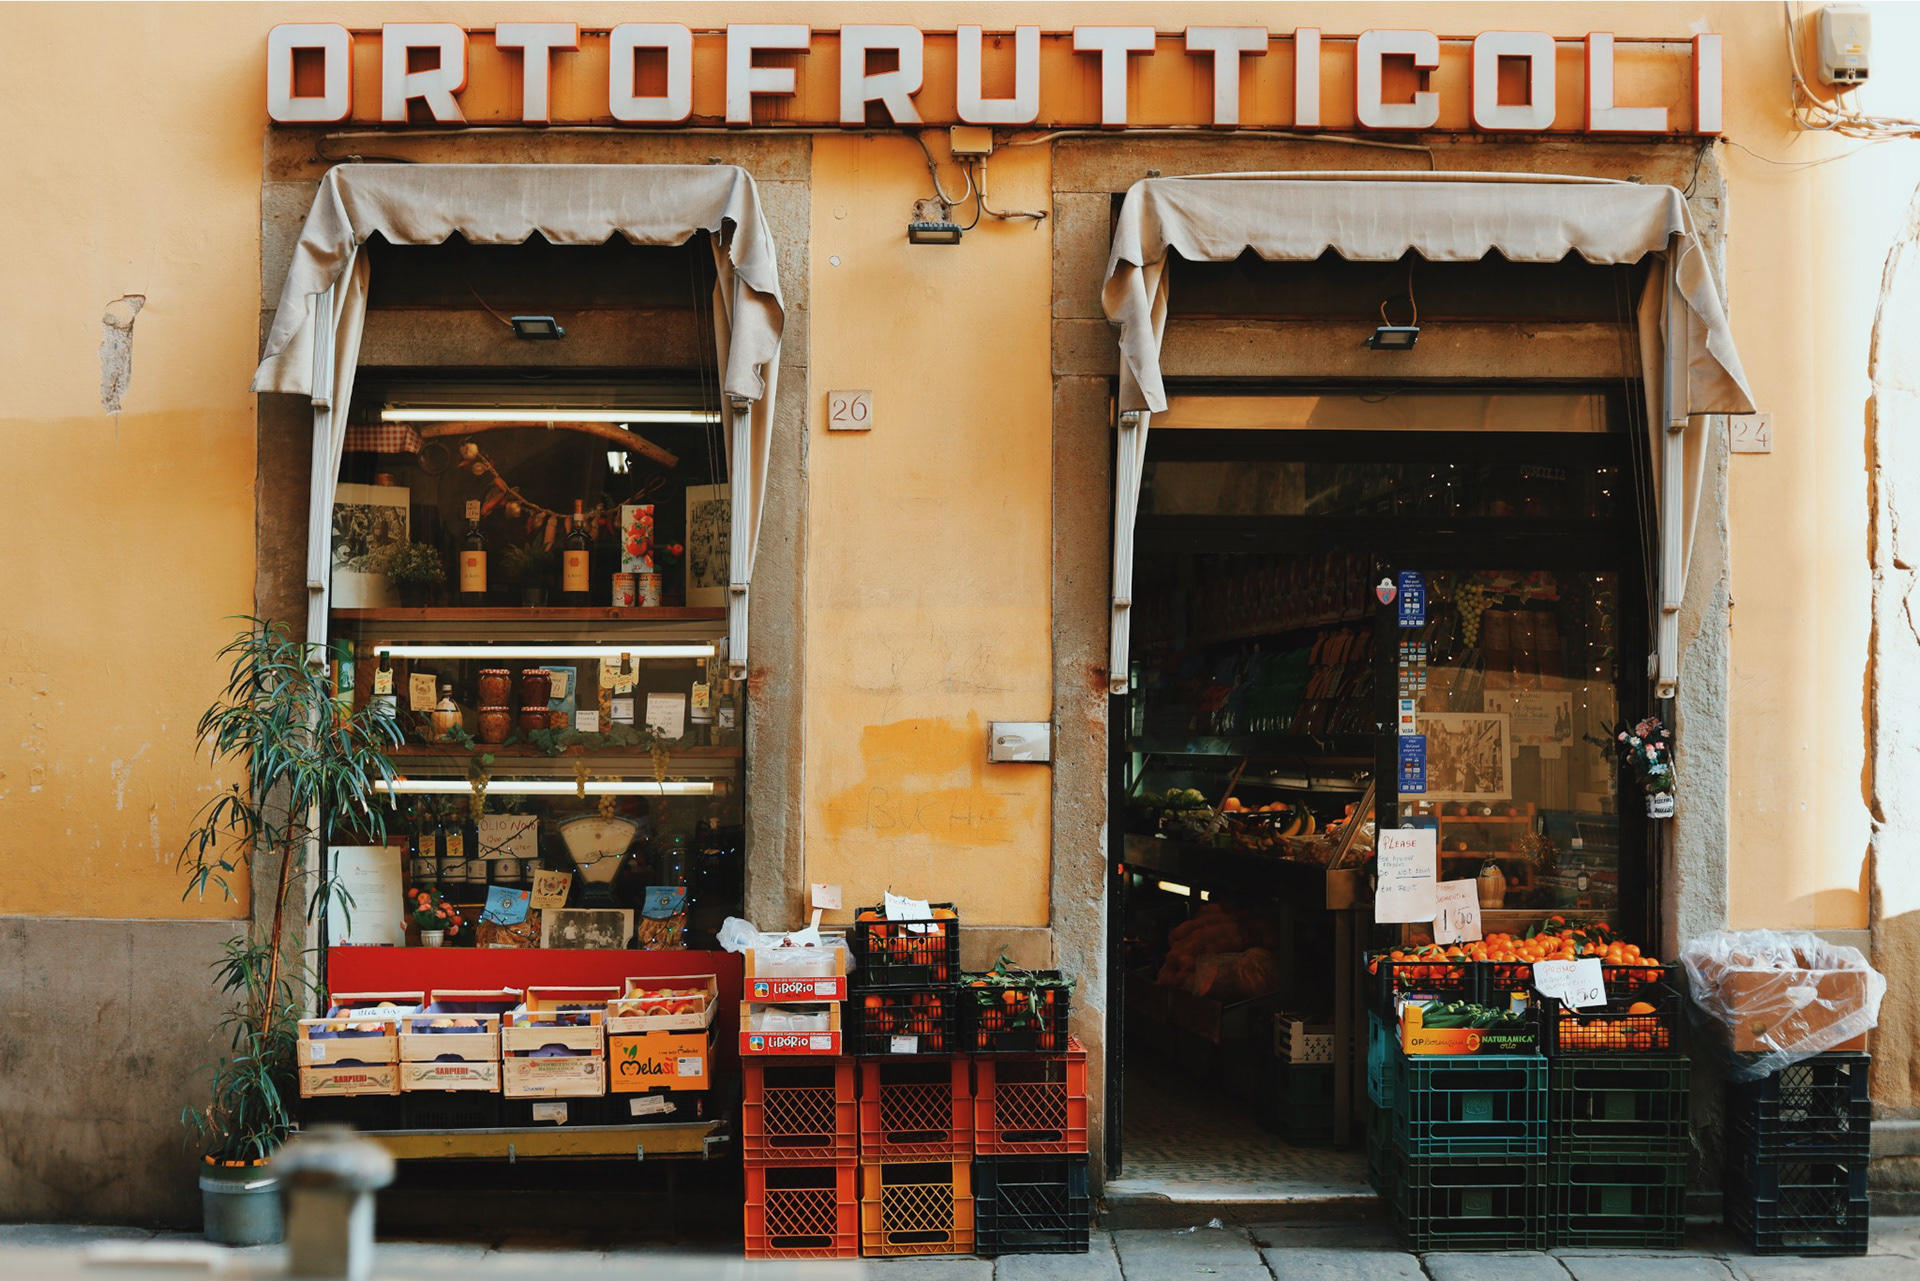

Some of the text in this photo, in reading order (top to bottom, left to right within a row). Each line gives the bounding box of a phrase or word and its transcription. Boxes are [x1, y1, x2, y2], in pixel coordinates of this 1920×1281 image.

[266, 22, 1723, 136] ORTOFRUTTICOLI
[832, 394, 867, 421] 26
[1735, 421, 1768, 447] 24
[481, 821, 507, 831] OLIO
[1383, 836, 1417, 850] PLEASE
[1543, 964, 1577, 974] PROMO
[1412, 1038, 1424, 1046] OP
[434, 1067, 469, 1075] SARPIERI
[333, 1075, 367, 1083] SARPIERI
